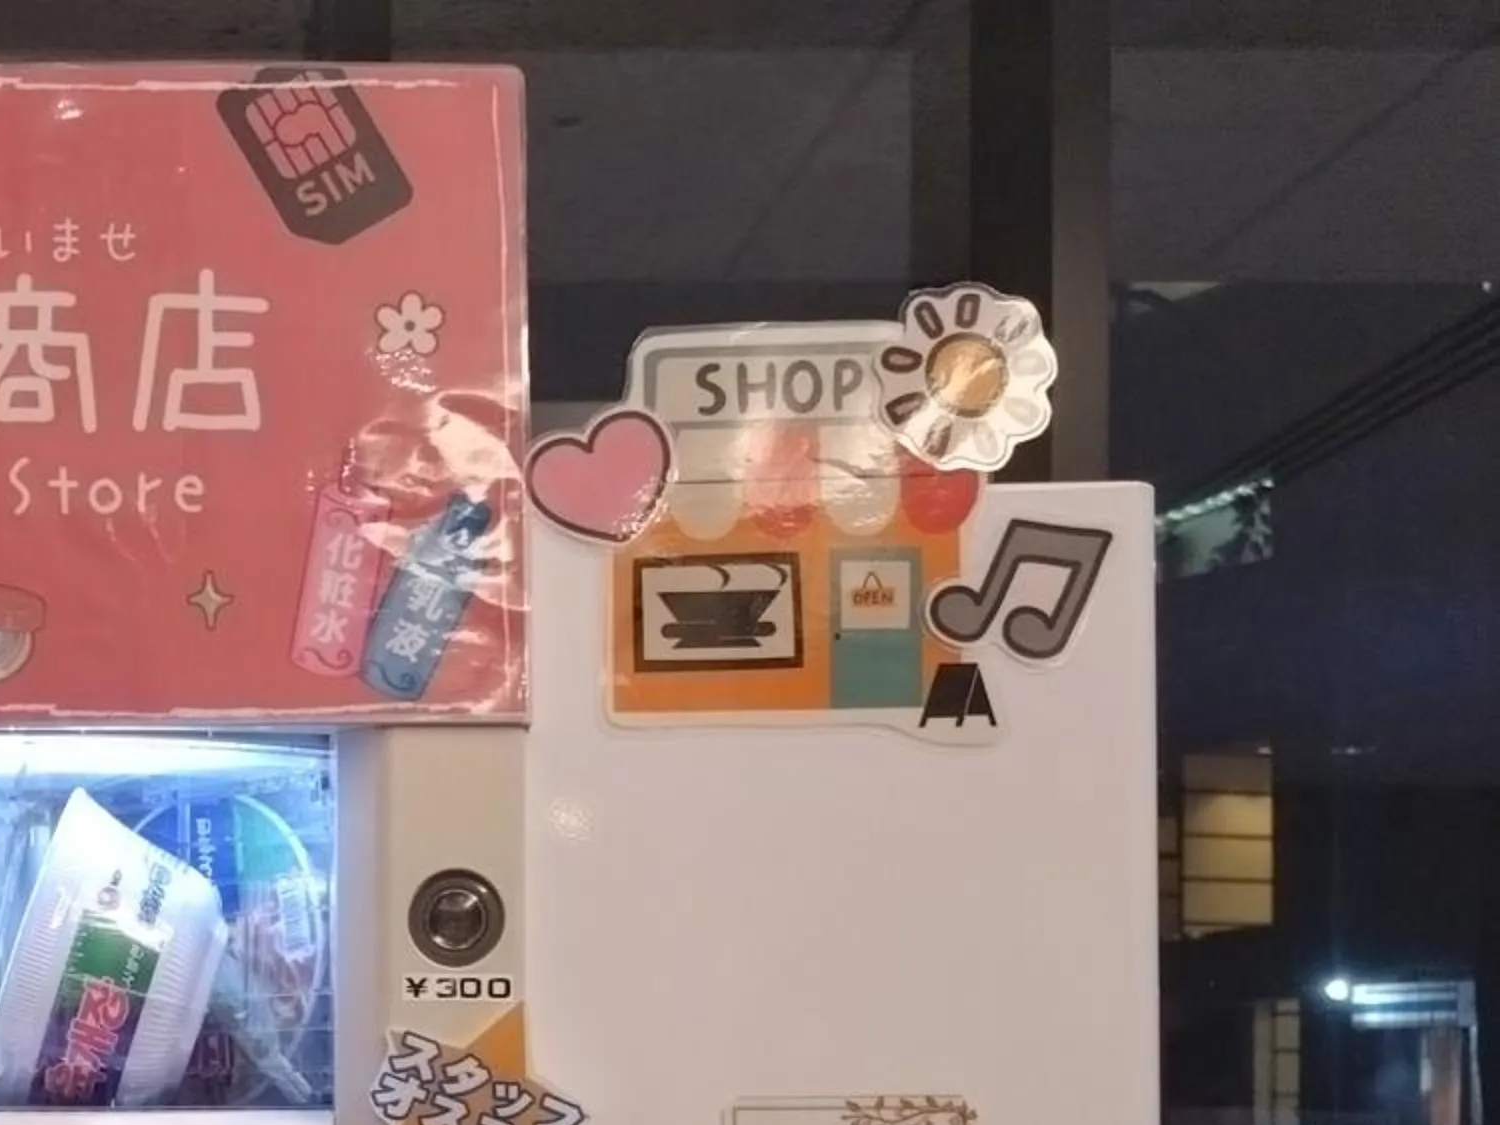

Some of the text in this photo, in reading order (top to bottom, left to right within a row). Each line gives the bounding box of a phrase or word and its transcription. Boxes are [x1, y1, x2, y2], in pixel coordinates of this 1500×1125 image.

[295, 153, 377, 217] SIM
[696, 359, 863, 416] SHOP
[8, 457, 205, 517] Store
[310, 533, 364, 648] 化粧水
[851, 588, 895, 607] OPEN
